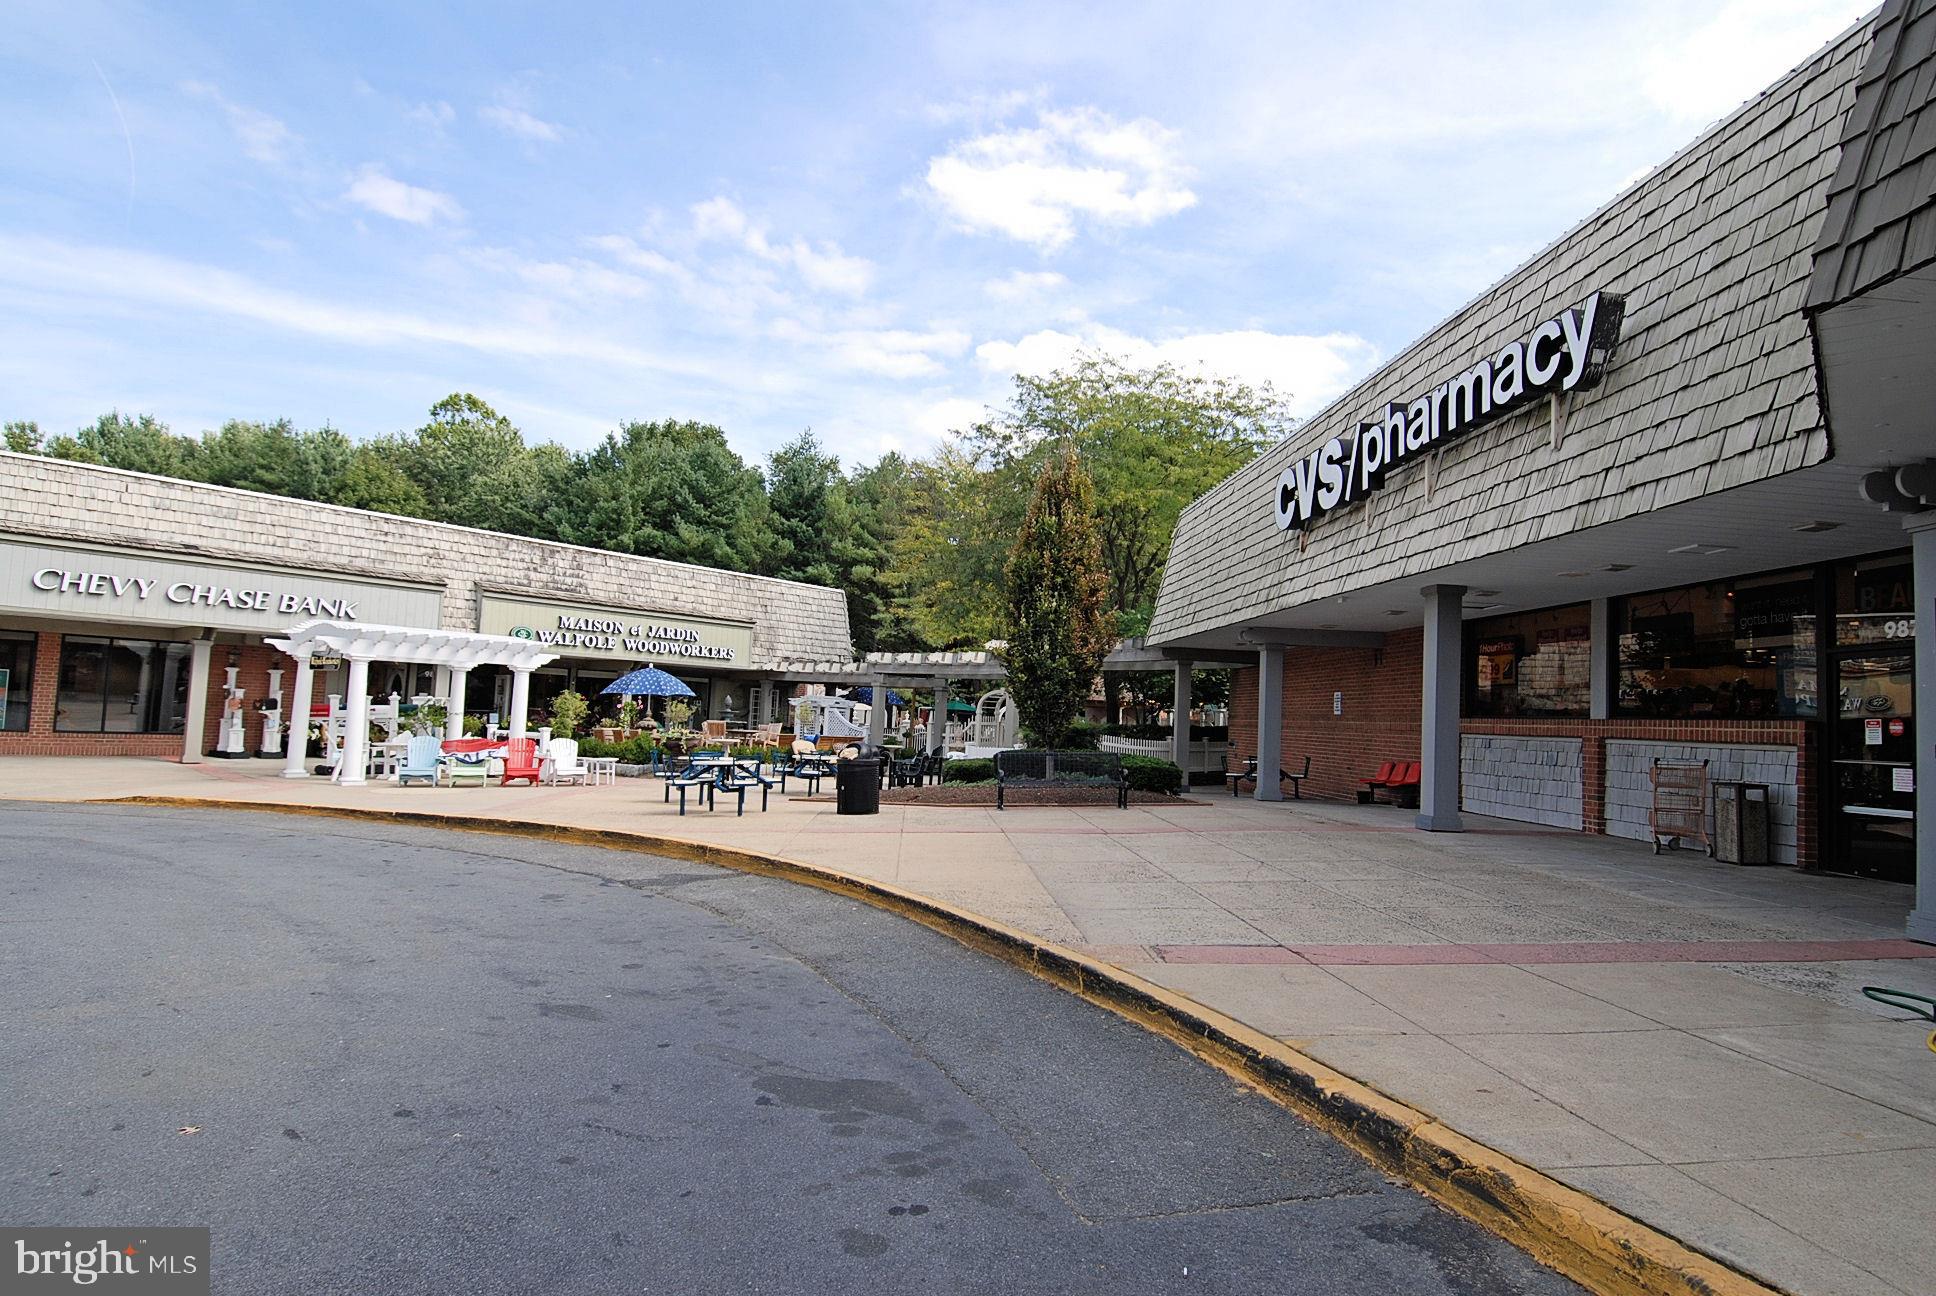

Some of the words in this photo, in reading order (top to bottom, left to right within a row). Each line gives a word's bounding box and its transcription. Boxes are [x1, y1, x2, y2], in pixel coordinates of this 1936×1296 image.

[1274, 291, 1600, 531] CVS/pharmacy
[32, 568, 157, 599] CHEVY
[166, 582, 272, 610] CHASE
[278, 594, 360, 620] BANK
[537, 630, 617, 650] WALPOLE
[623, 638, 735, 660] WOODWORKERS
[559, 616, 625, 634] MAISON
[630, 625, 642, 636] et
[648, 626, 700, 642] JARDIN
